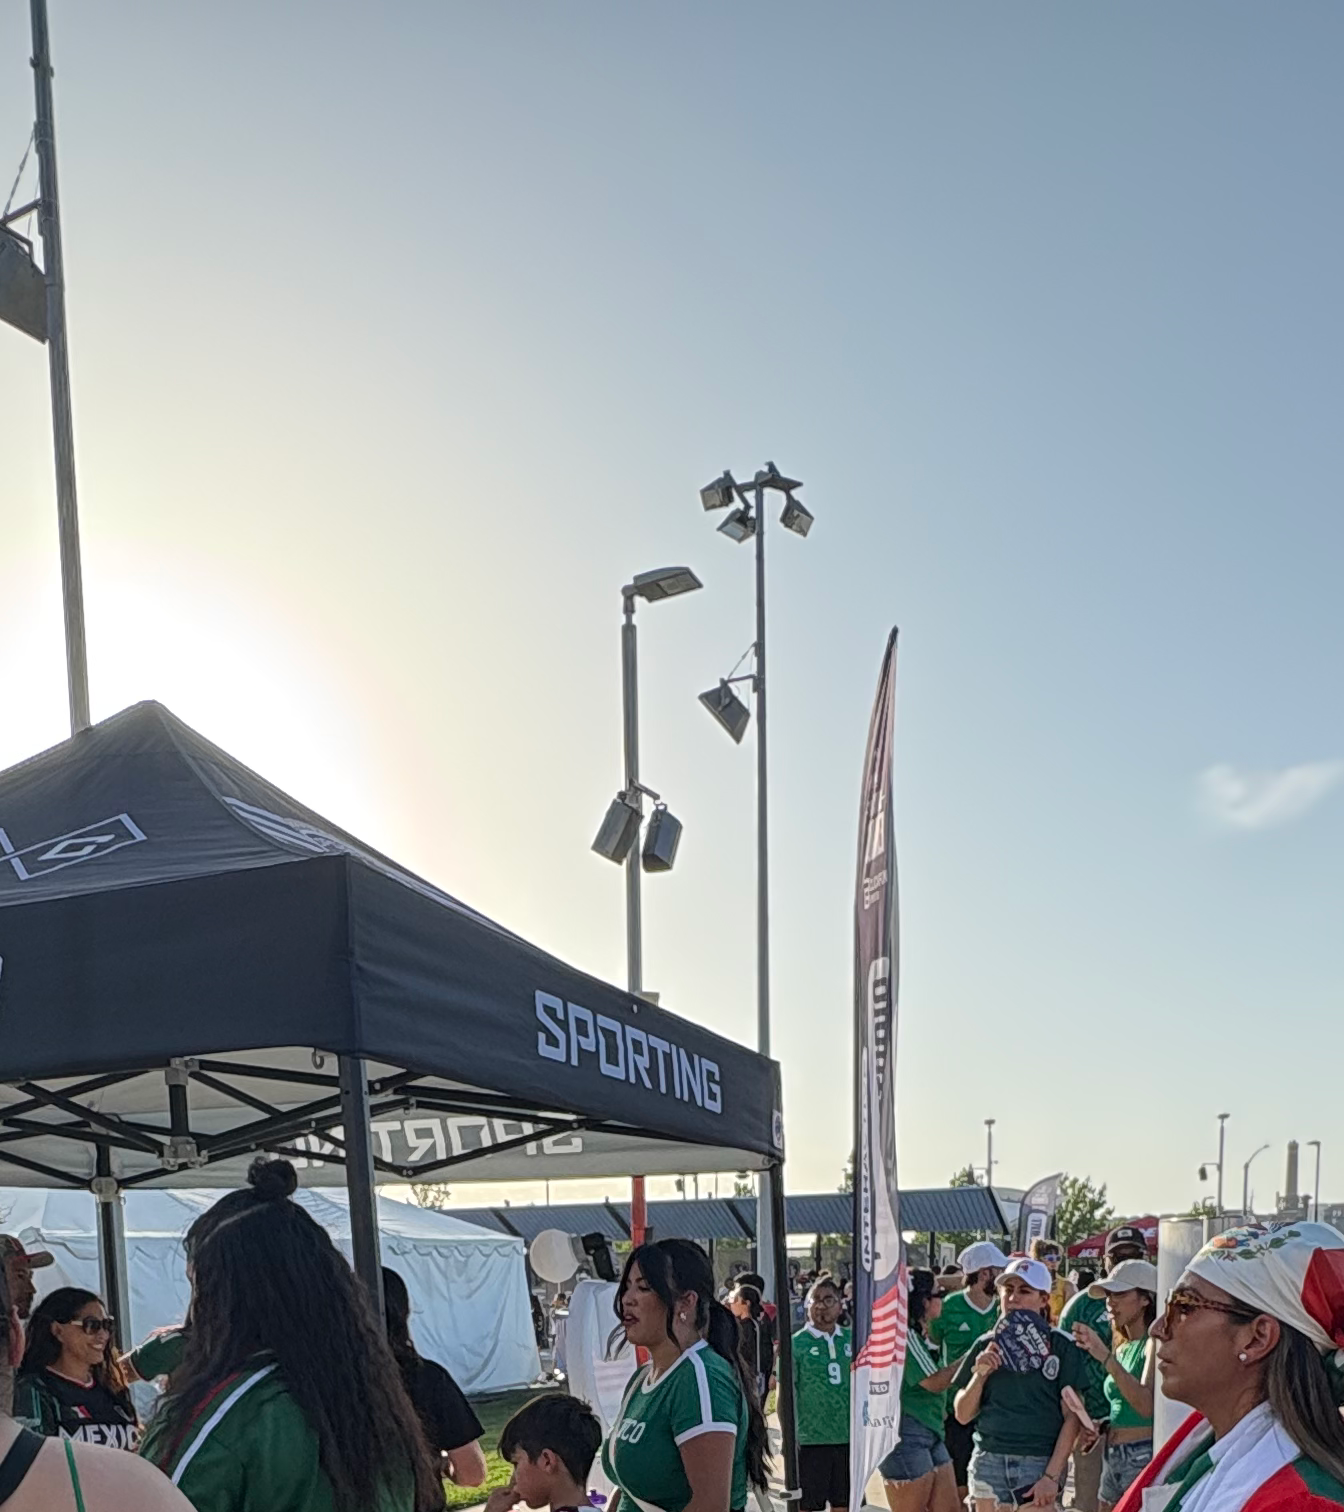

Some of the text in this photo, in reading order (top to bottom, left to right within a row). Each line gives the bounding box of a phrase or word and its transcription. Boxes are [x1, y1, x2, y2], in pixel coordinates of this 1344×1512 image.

[534, 989, 722, 1115] SPORTING
[828, 1362, 841, 1385] 9
[58, 1423, 139, 1451] MEXIC
